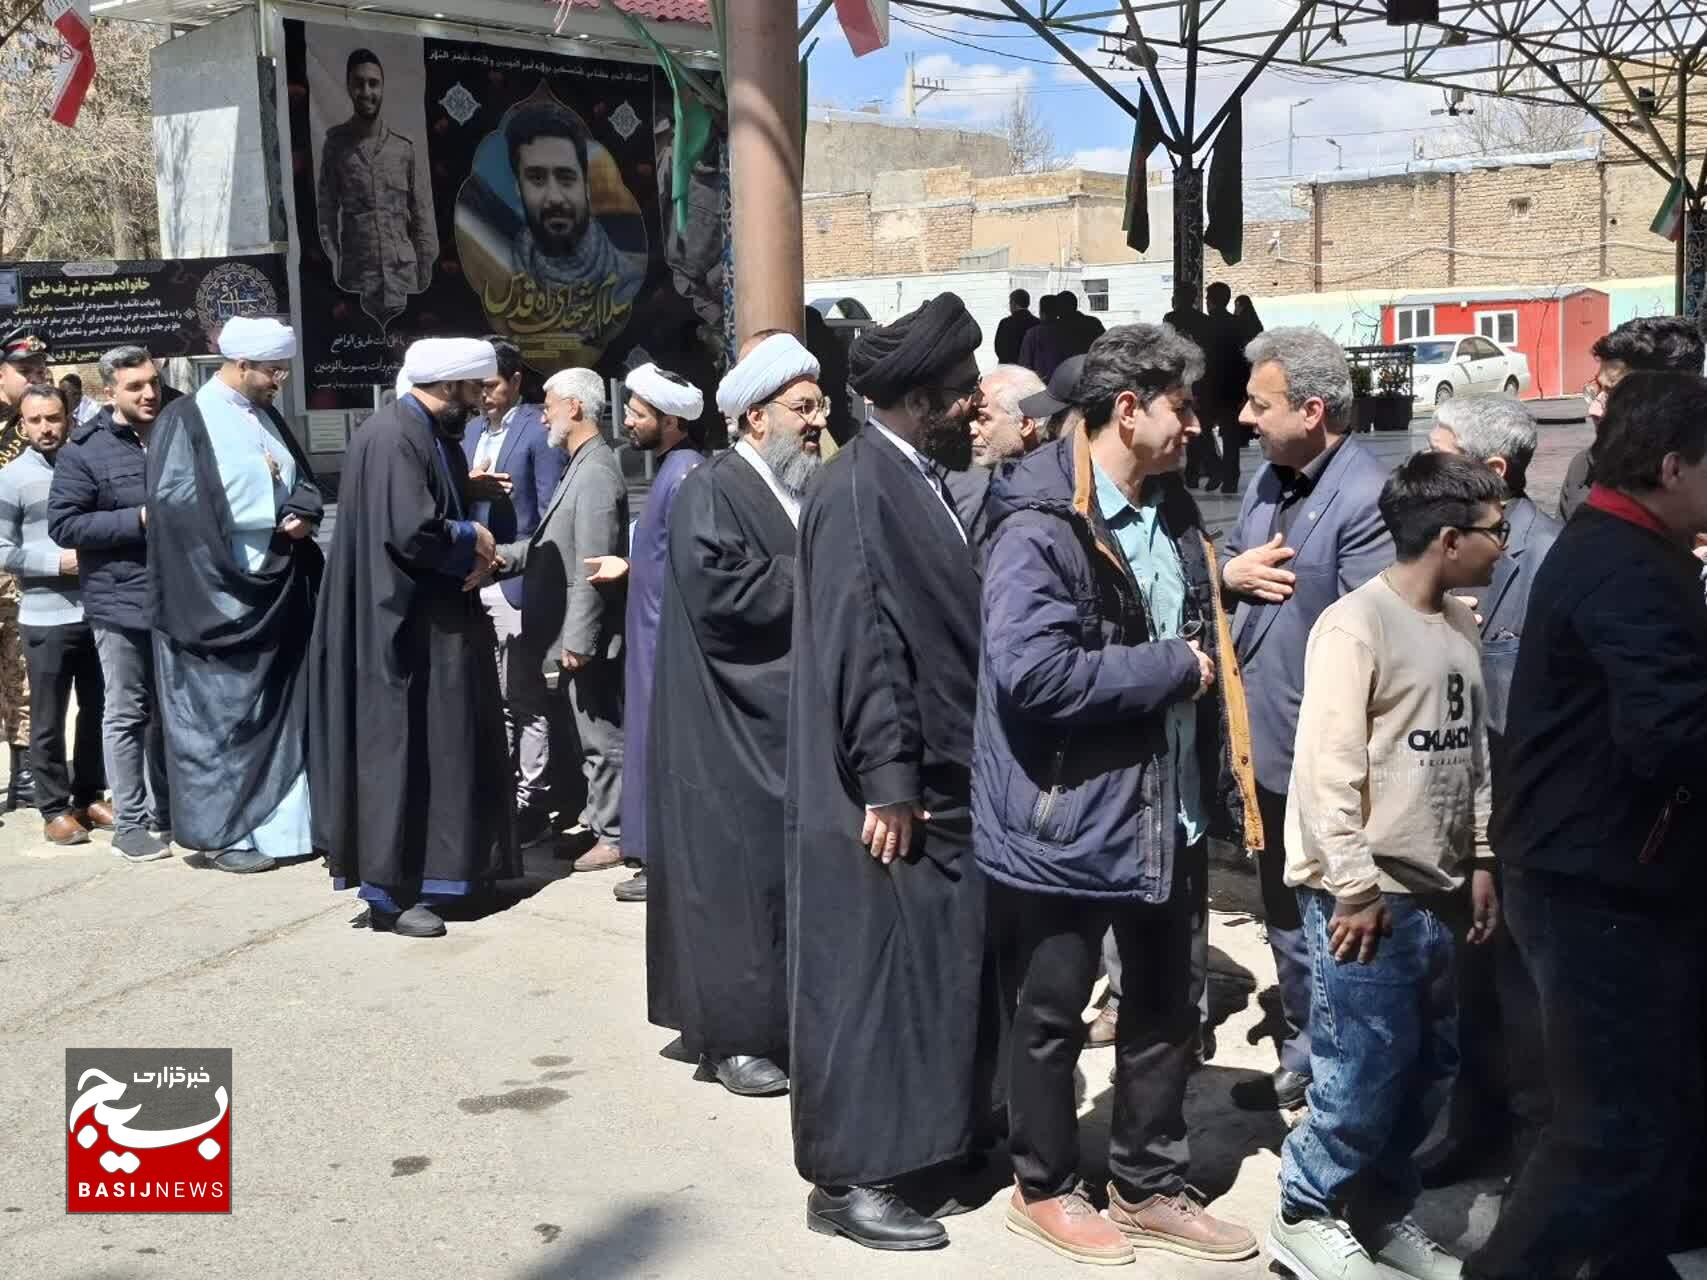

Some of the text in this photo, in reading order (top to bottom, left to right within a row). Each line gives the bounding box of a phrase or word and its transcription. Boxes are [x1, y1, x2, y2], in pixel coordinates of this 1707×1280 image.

[28, 276, 151, 298] خانواده محترم شریف طبع
[1447, 673, 1465, 720] B
